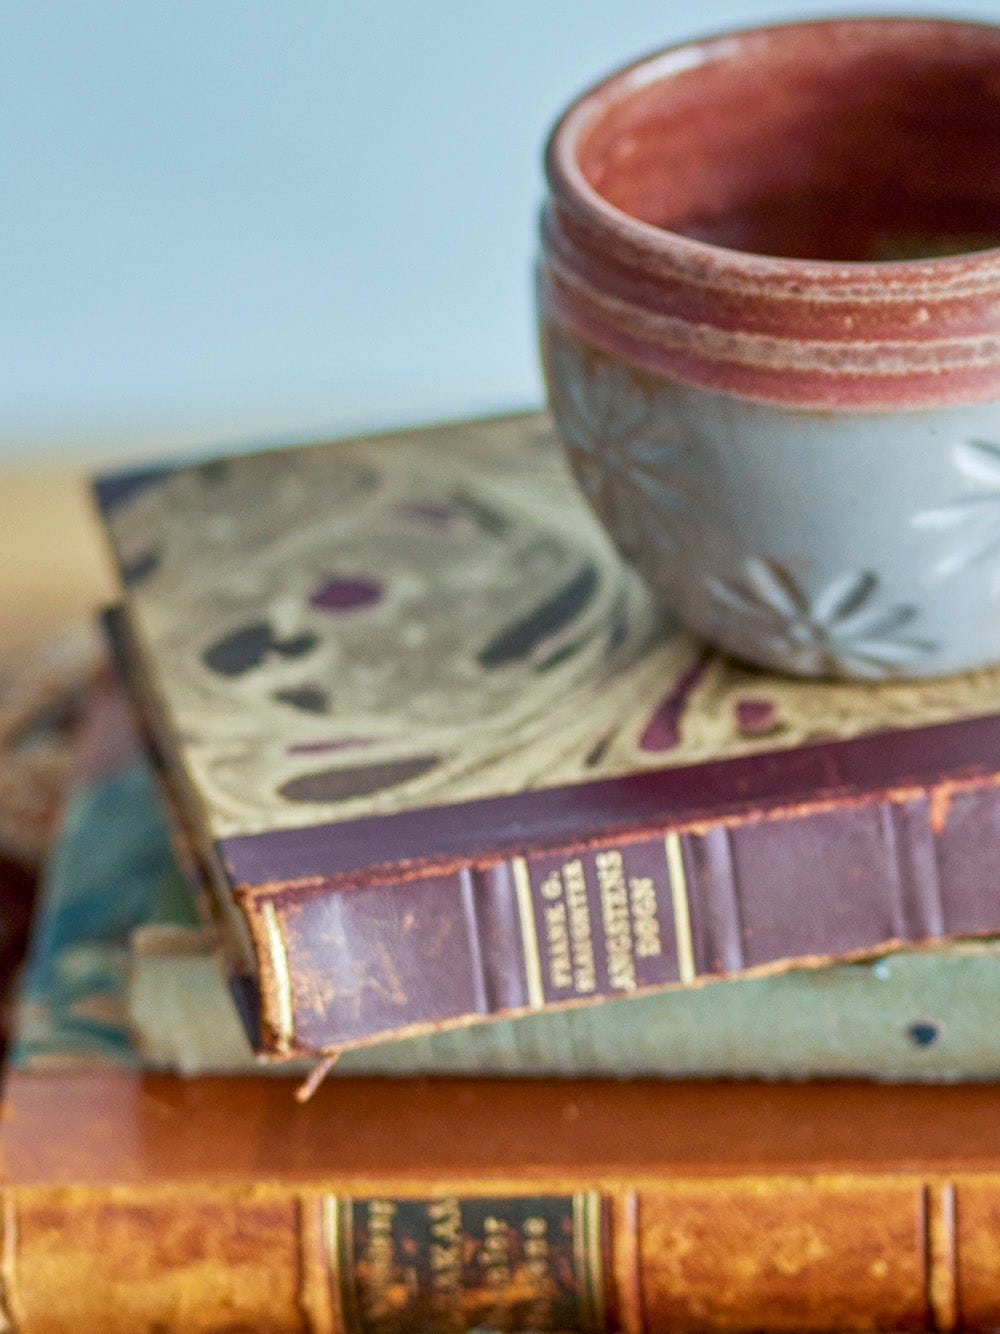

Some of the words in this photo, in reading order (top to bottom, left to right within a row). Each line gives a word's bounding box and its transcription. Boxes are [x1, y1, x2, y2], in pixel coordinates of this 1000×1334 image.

[540, 870, 563, 900] G.
[595, 850, 637, 991] ANGSTENS
[544, 901, 573, 988] FRANK
